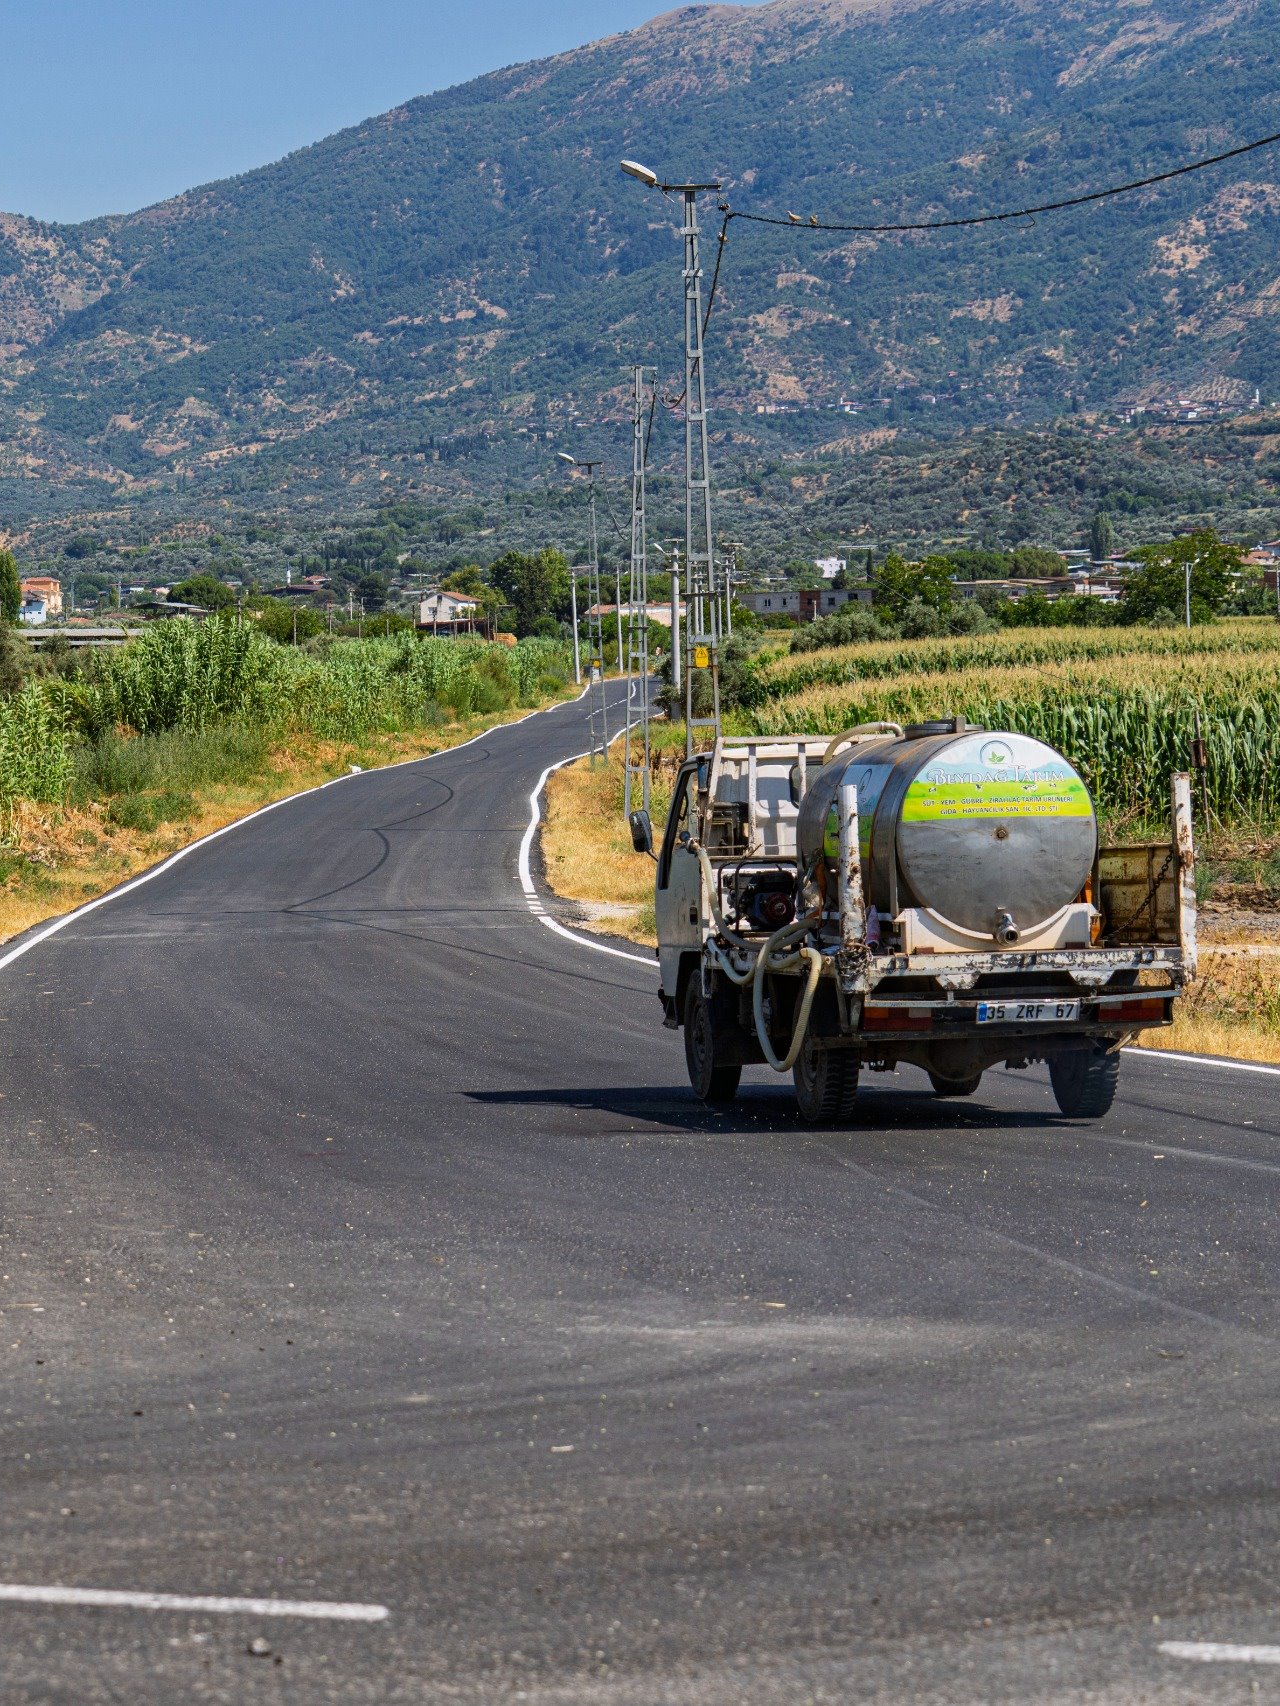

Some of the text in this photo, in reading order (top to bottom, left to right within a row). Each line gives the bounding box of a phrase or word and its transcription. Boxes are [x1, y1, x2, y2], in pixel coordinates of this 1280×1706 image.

[927, 765, 1065, 785] BEYDAĞ TARIM
[987, 1005, 1005, 1020] 35
[1016, 1004, 1045, 1019] ZRF
[1055, 1003, 1075, 1018] 67
